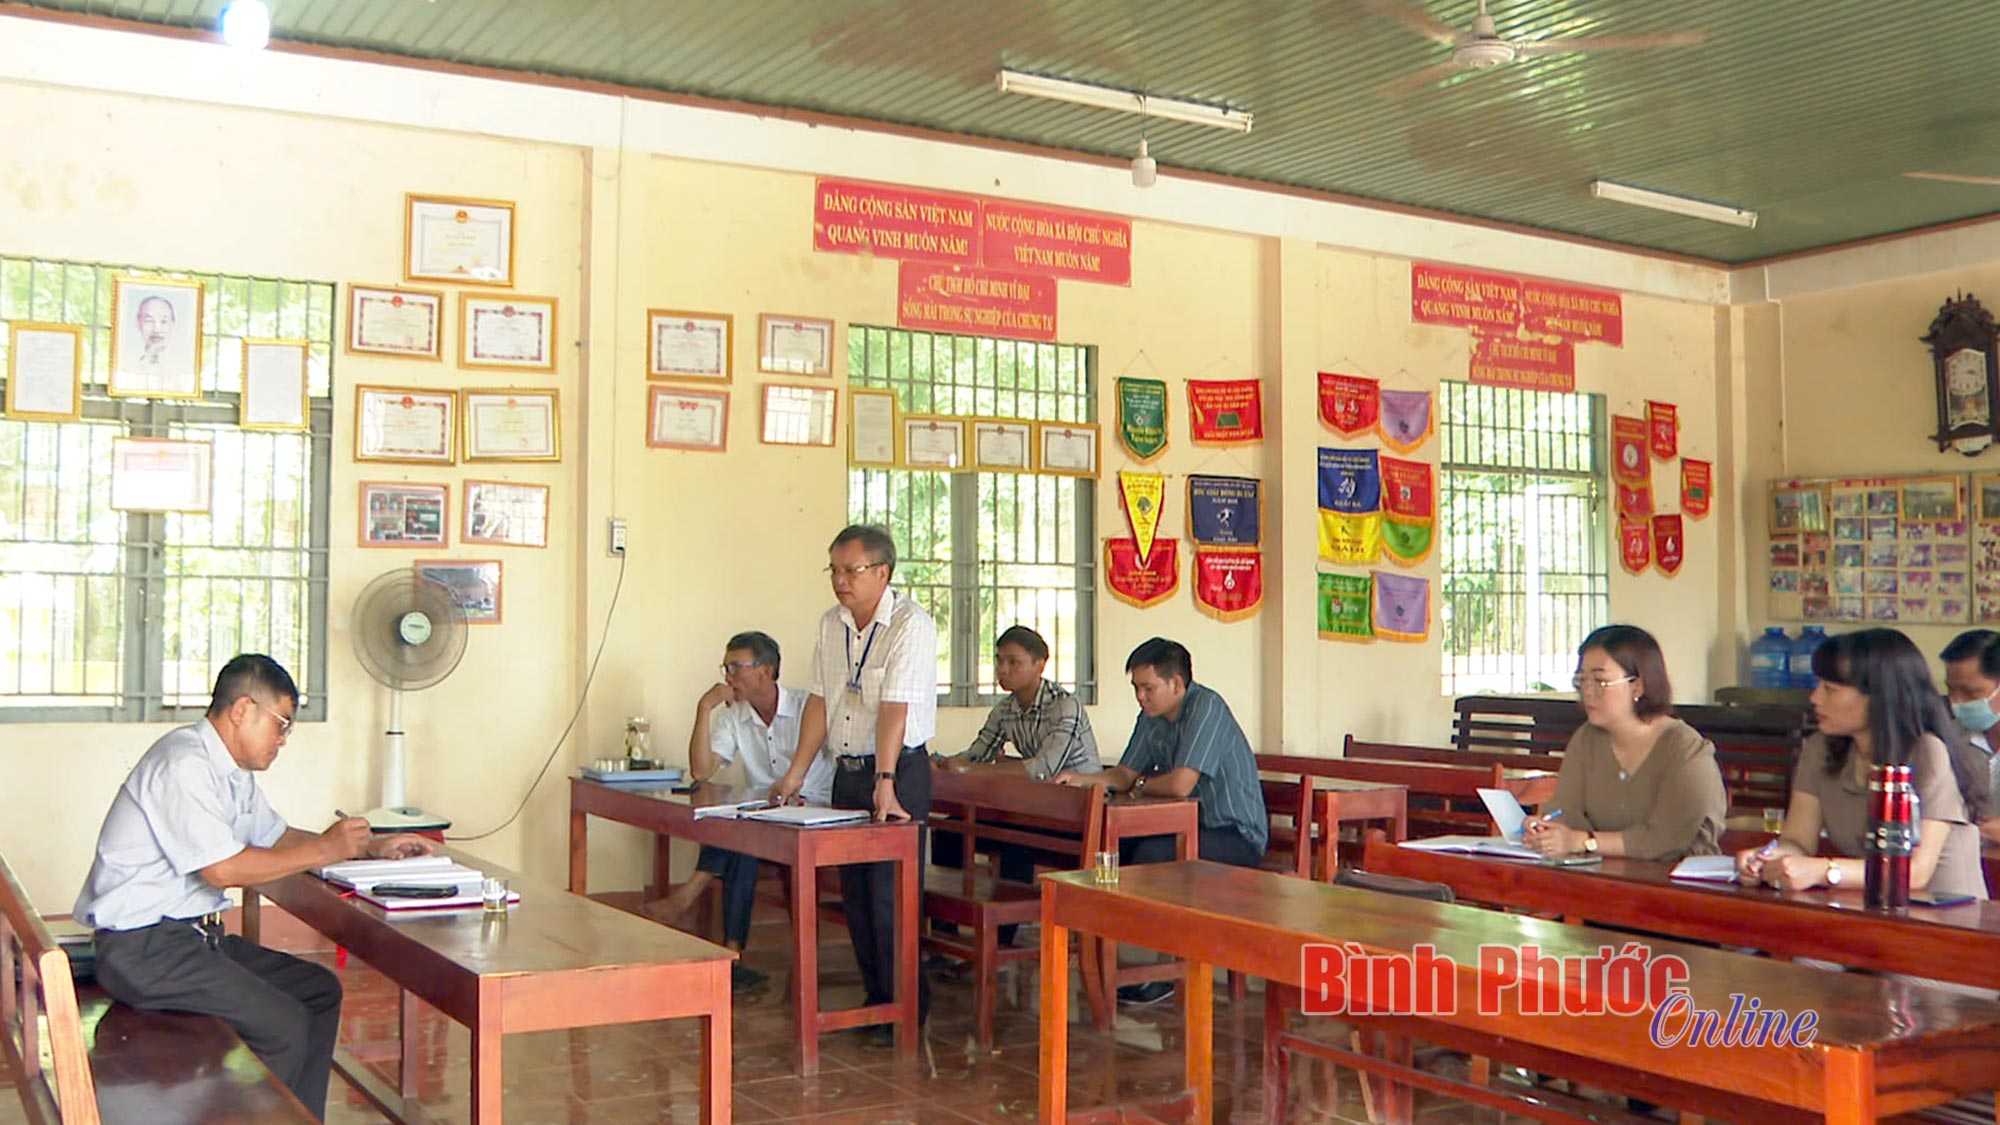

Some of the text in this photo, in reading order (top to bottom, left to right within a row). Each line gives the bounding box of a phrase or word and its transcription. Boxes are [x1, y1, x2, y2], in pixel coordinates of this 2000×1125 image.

[824, 188, 974, 228] ĐẢNG CỘNG SẢN VIỆT NAM
[827, 223, 968, 256] QUANG VINH MUÔN NĂM!
[985, 211, 1010, 233] NƯỚC
[1011, 214, 1035, 238] CỘNG
[1036, 219, 1055, 239] HÒA
[1067, 221, 1083, 245] HỘI
[1083, 225, 1101, 246] CHỦ
[1102, 228, 1128, 249] NGHĨA
[1013, 242, 1034, 267] VIỆT
[1035, 248, 1055, 267] NAM
[1055, 250, 1079, 270] MUÔN
